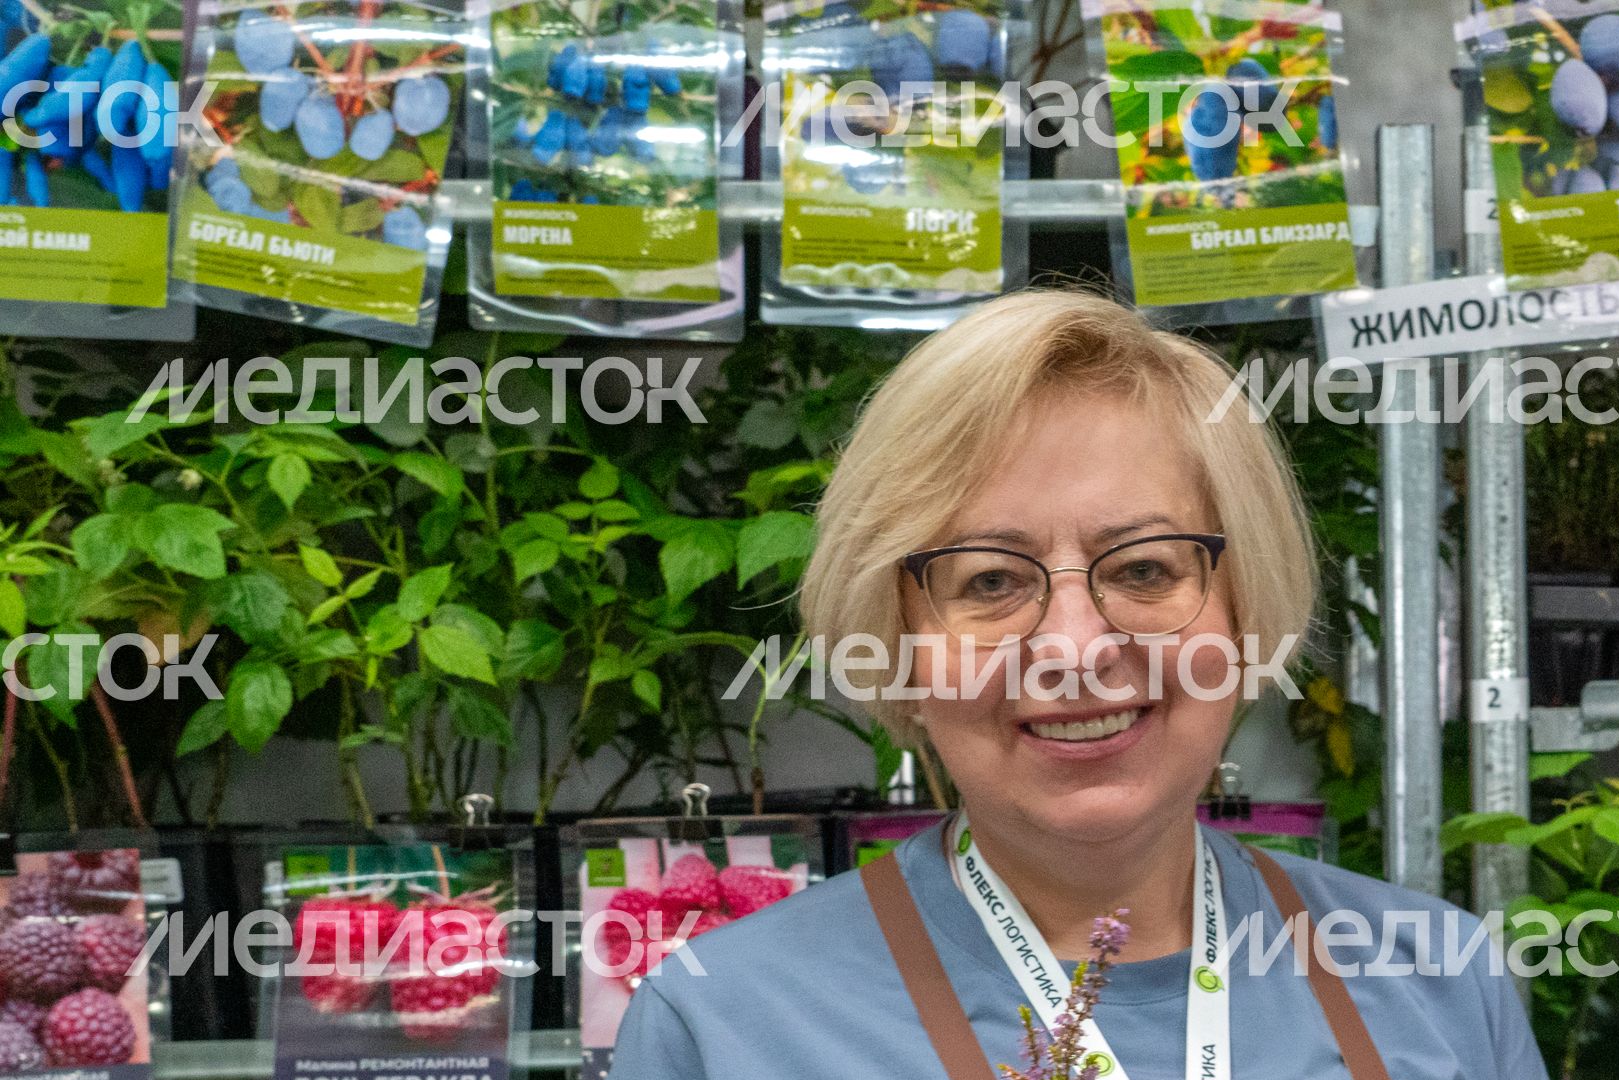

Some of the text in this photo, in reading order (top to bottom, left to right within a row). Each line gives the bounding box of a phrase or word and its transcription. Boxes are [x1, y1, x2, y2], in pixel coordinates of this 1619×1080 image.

[32, 231, 91, 252] БАНАН
[189, 220, 265, 252] БОРЕАЛ
[268, 234, 335, 265] БЬЮТИ
[503, 225, 573, 245] МОРЕНА
[1190, 221, 1351, 250] БОРЕАЛ БЛИЗЗАРД
[1349, 287, 1619, 348] ЖИМОЛОСТЬ
[1487, 687, 1501, 708] 2
[964, 855, 1064, 1009] ФЛЕКС ЛОГИСТИКА
[1204, 904, 1218, 963] ФЛЕКС
[359, 1057, 490, 1071] РЕМОНТАНТНАЯ
